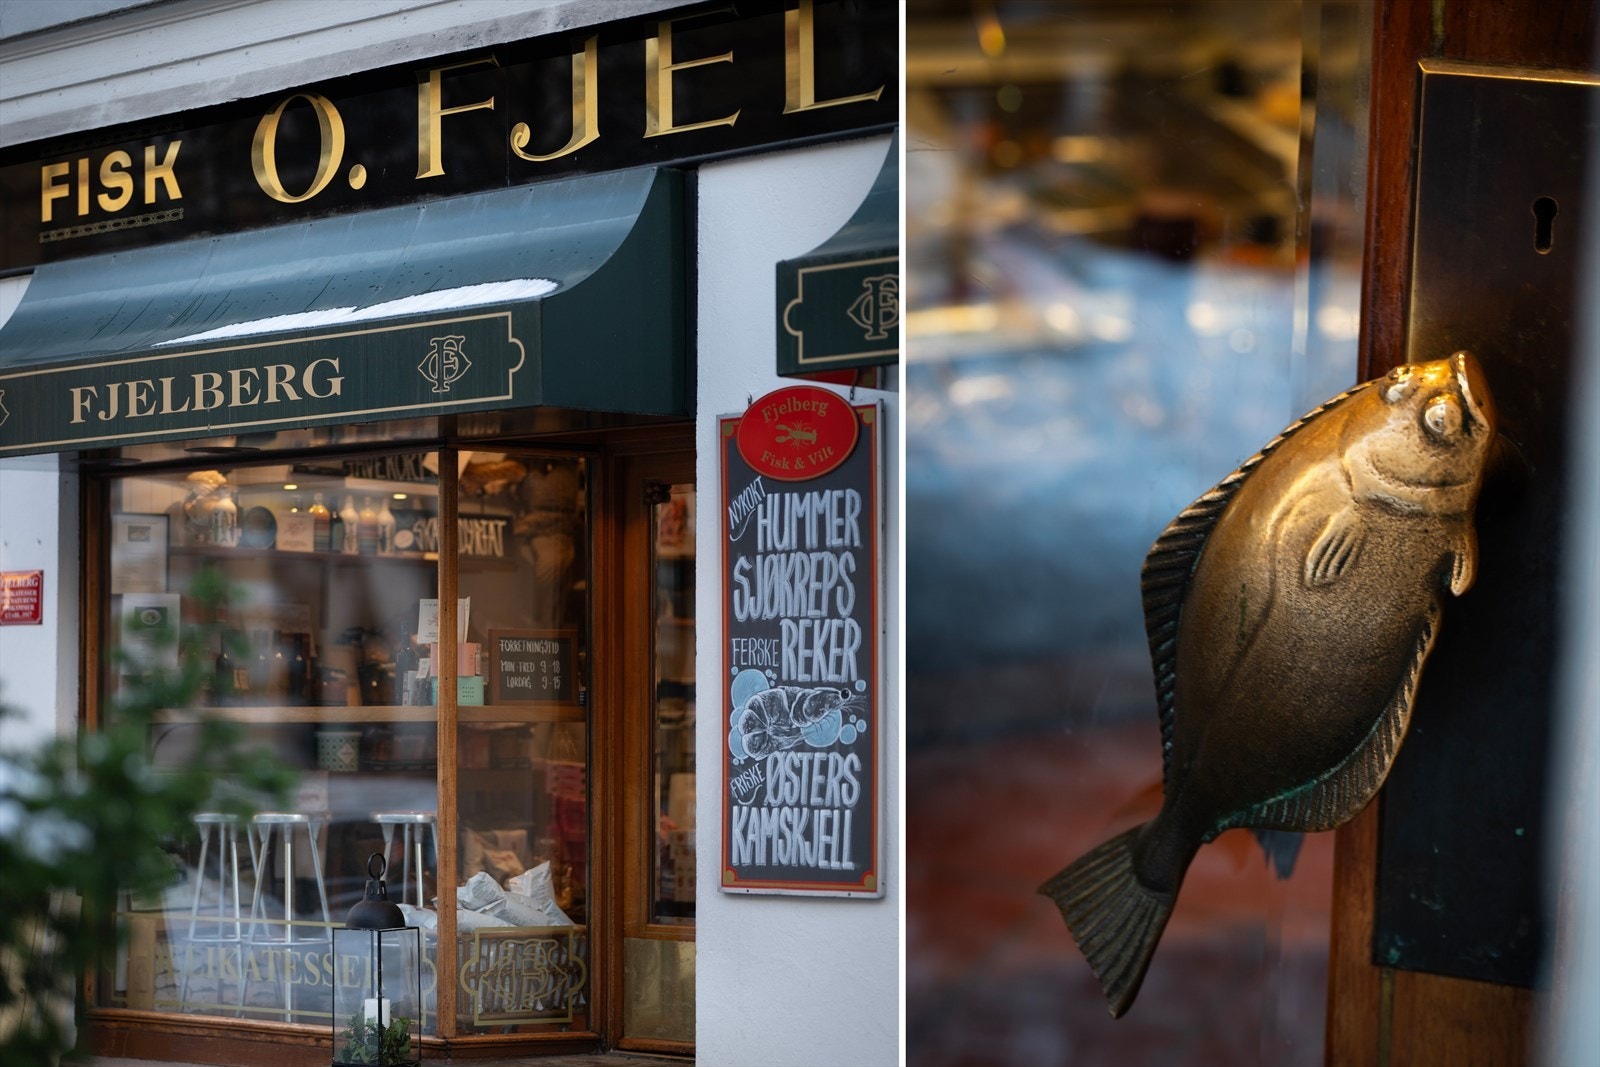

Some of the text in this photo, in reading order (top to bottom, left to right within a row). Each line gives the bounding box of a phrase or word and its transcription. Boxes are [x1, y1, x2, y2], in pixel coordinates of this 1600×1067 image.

[251, 93, 367, 204] O.
[41, 140, 184, 223] FISK
[70, 357, 346, 424] FJELBERG
[761, 397, 829, 423] Fjelberg
[760, 446, 835, 470] Fisk & Vilt
[728, 475, 766, 530] NYKOKT
[757, 489, 863, 553] HUMMER
[733, 551, 857, 622] SJØKREPS
[731, 618, 862, 683] FERSKE REKER
[730, 751, 862, 807] FRISKE ØSTERS
[731, 805, 856, 870] KAMSKJELL
